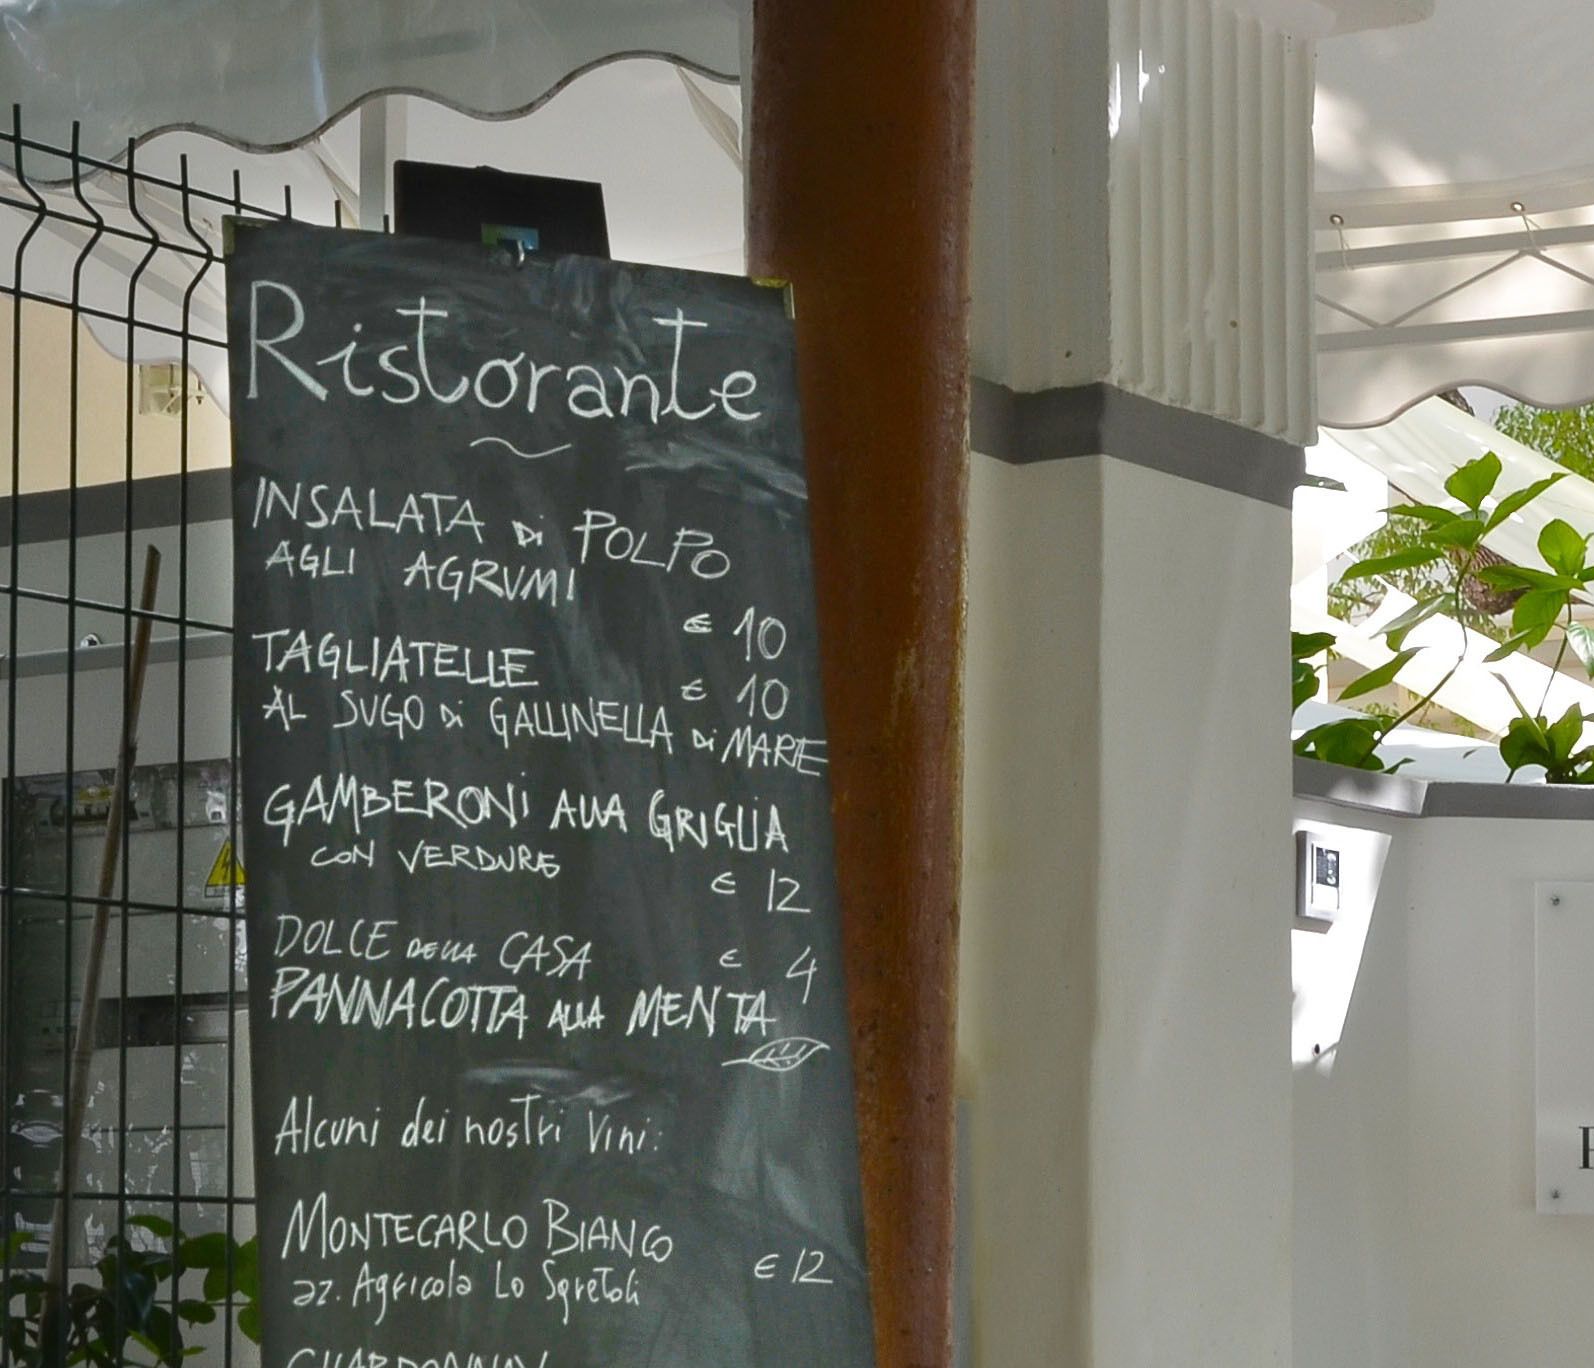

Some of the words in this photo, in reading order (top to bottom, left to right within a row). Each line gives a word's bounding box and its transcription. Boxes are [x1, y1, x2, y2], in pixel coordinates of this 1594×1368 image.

[246, 280, 762, 424] Ristorante
[252, 476, 485, 543] INSALATA
[573, 509, 730, 579] POLPO
[264, 540, 356, 577] AGLI
[252, 629, 539, 687] TAGLIATELLE
[733, 606, 786, 660] 10
[736, 675, 789, 719] 10
[263, 685, 307, 731] AL
[721, 731, 829, 778] MARE
[649, 788, 790, 853] GRIGLIA
[767, 868, 811, 913] 12
[275, 914, 398, 960] DOLCE
[499, 932, 593, 980] CASA
[786, 946, 818, 1004] 4
[270, 968, 528, 1040] PANNACOTTA
[547, 993, 605, 1037] ALLA
[626, 985, 777, 1037] MENTA
[275, 1097, 379, 1155] Alcuni
[401, 1097, 446, 1148] dei
[465, 1094, 564, 1148] nostri
[352, 1258, 471, 1325] Agricola
[495, 1261, 525, 1299] Lo
[792, 1250, 833, 1284] 12
